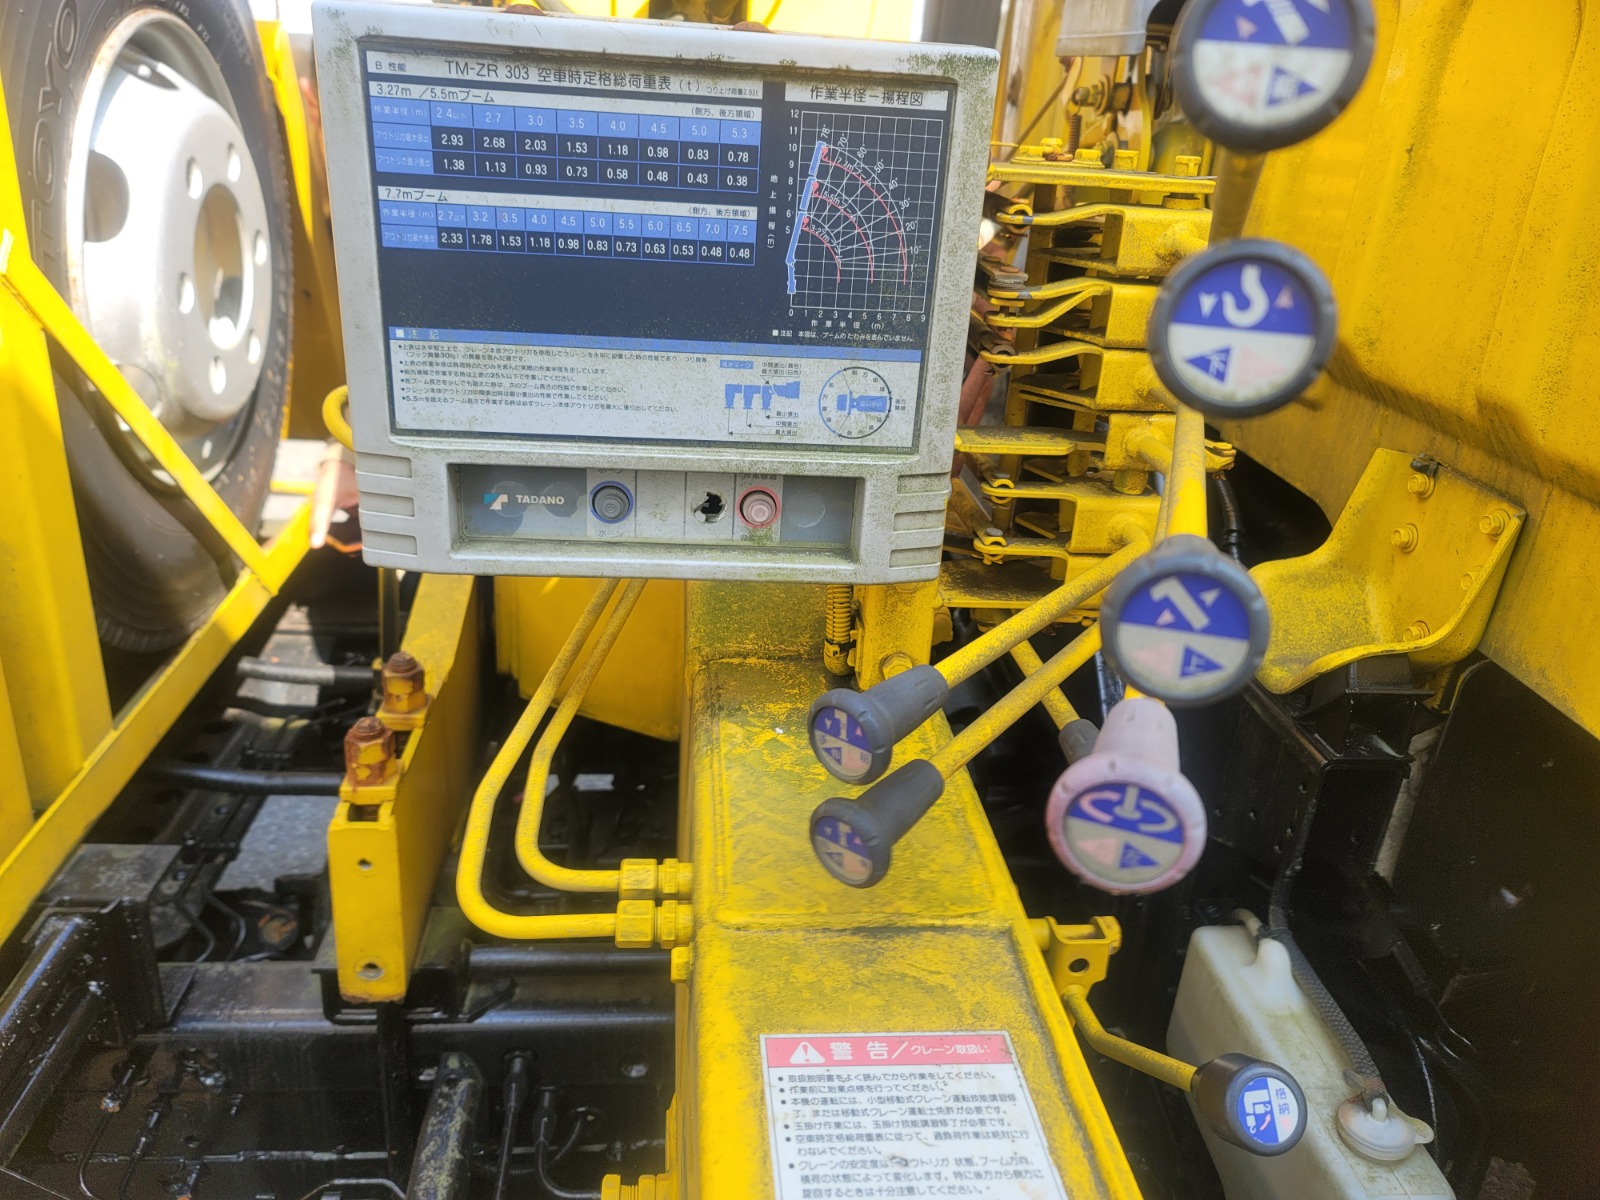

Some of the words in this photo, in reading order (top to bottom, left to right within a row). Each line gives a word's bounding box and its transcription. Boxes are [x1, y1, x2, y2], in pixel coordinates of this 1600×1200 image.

[375, 61, 382, 69] B
[389, 62, 406, 71] 性能
[445, 60, 498, 78] TM-ZR
[505, 65, 529, 80] 303
[538, 67, 671, 91] 空車時定格総荷重表
[377, 84, 412, 97] 3.27m
[790, 109, 799, 118] 12
[485, 112, 501, 123] 2.7
[528, 115, 543, 126] 3.0
[569, 118, 585, 129] 3.5
[610, 120, 626, 131] 4.0
[651, 122, 667, 134] 4.5
[691, 125, 707, 136] 5.0
[732, 128, 747, 139] 5.3
[789, 126, 798, 135] 11
[31, 0, 79, 266] TOYO
[441, 134, 464, 146] 2.93
[483, 137, 505, 148] 2.68
[525, 139, 547, 151] 2.03
[567, 142, 588, 153] 1.53
[607, 144, 628, 156] 1.18
[647, 146, 669, 158] 0.98
[688, 149, 709, 161] 0.83
[728, 151, 749, 163] 0.78
[788, 143, 797, 151] 10
[856, 143, 868, 158] 60°
[789, 160, 794, 168] 9
[873, 158, 885, 174] 50°
[443, 159, 465, 171] 1.38
[485, 161, 506, 173] 1.13
[525, 163, 547, 175] 0.93
[566, 166, 588, 178] 0.73
[607, 168, 628, 180] 0.58
[647, 171, 668, 182] 0.48
[687, 173, 708, 184] 0.43
[727, 175, 748, 186] 0.38
[788, 177, 793, 185] 8
[888, 177, 899, 191] 40°
[385, 188, 448, 202] 7.7mブーム
[787, 193, 792, 202] 7
[899, 197, 911, 210] 30°
[786, 209, 792, 218] 6
[473, 211, 488, 222] 3.2
[502, 213, 518, 224] 3.5
[531, 214, 547, 225] 4.0
[561, 216, 576, 226] 4.5
[590, 217, 605, 228] 5.0
[619, 219, 634, 229] 5.5
[648, 221, 663, 231] 6.0
[676, 222, 691, 232] 6.5
[705, 224, 720, 234] 7.0
[734, 226, 748, 236] 7.5
[785, 226, 791, 234] 5
[905, 220, 918, 231] 20°
[441, 232, 463, 244] 2.33
[472, 234, 492, 245] 1.78
[501, 236, 521, 246] 1.53
[530, 237, 551, 248] 1.18
[558, 238, 579, 249] 0.98
[587, 240, 608, 251] 0.83
[616, 242, 637, 252] 0.73
[644, 243, 665, 254] 0.63
[673, 245, 694, 255] 0.53
[701, 246, 722, 257] 0.48
[729, 248, 750, 259] 0.48
[910, 245, 921, 255] 10°
[789, 309, 794, 317] 0
[833, 311, 838, 319] 3
[862, 312, 867, 320] 5
[515, 495, 565, 505] TADANO
[829, 1041, 889, 1060] 警告
